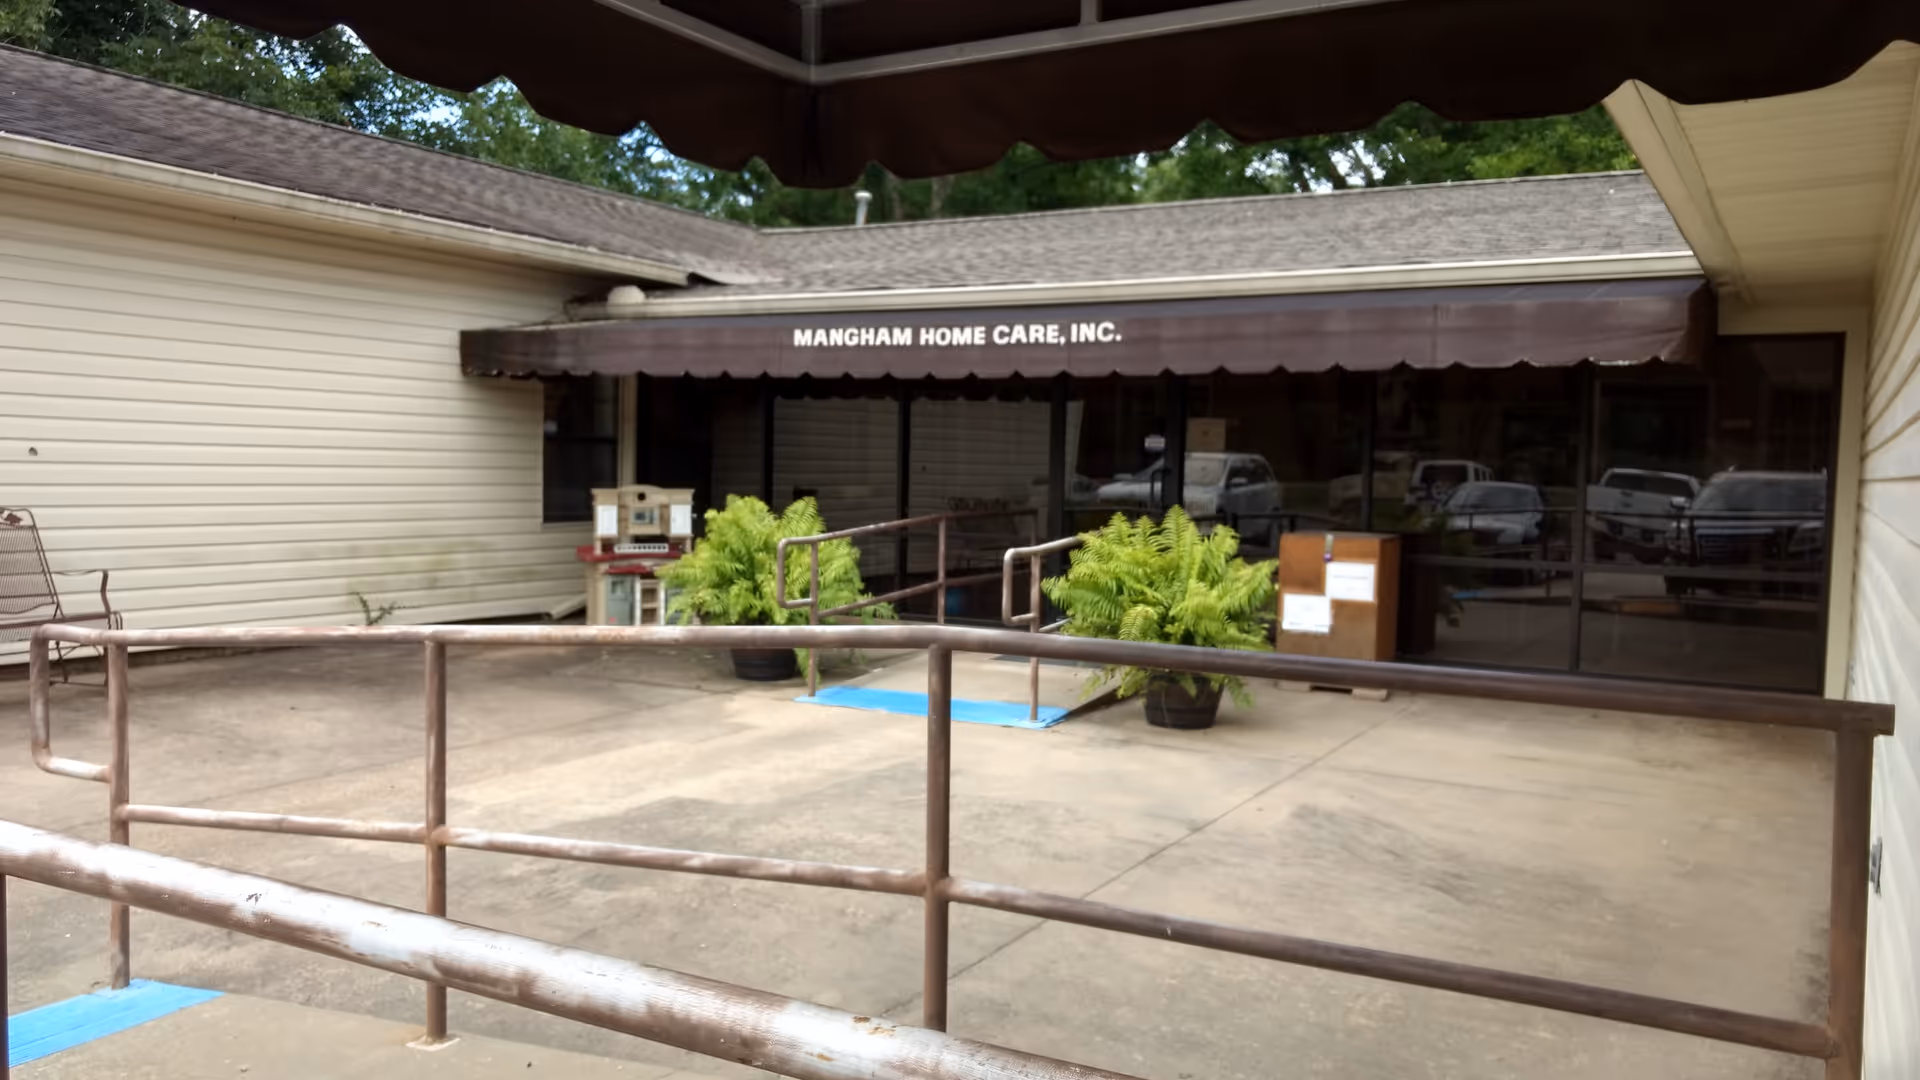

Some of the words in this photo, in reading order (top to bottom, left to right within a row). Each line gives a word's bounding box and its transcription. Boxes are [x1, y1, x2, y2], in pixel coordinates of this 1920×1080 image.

[793, 327, 913, 347] MANGHAM
[919, 326, 987, 346] HOME
[993, 323, 1067, 346] CARE,
[1071, 321, 1123, 343] INC.
